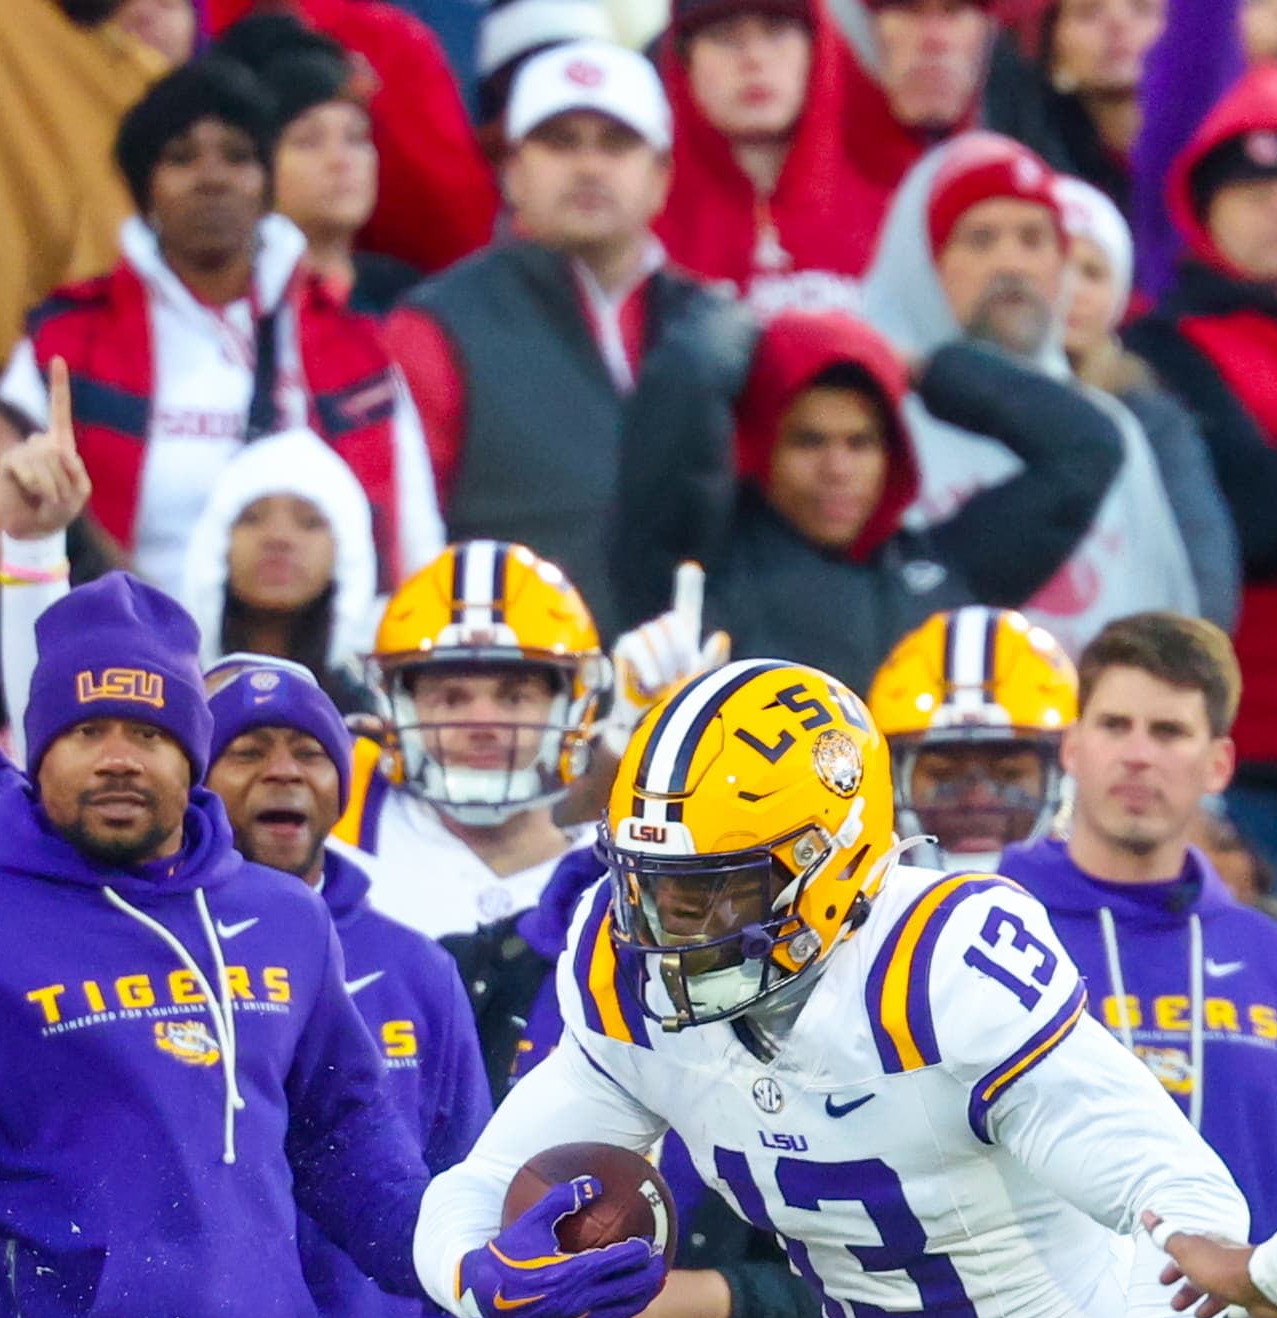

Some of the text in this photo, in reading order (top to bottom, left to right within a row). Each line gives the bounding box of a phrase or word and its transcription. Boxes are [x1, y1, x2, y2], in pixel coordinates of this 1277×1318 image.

[77, 667, 165, 708] LSU
[733, 682, 870, 765] LSU
[629, 823, 667, 845] LSU
[963, 905, 1059, 1013] 13
[26, 965, 292, 1025] TIGERS
[757, 1130, 809, 1152] LSU
